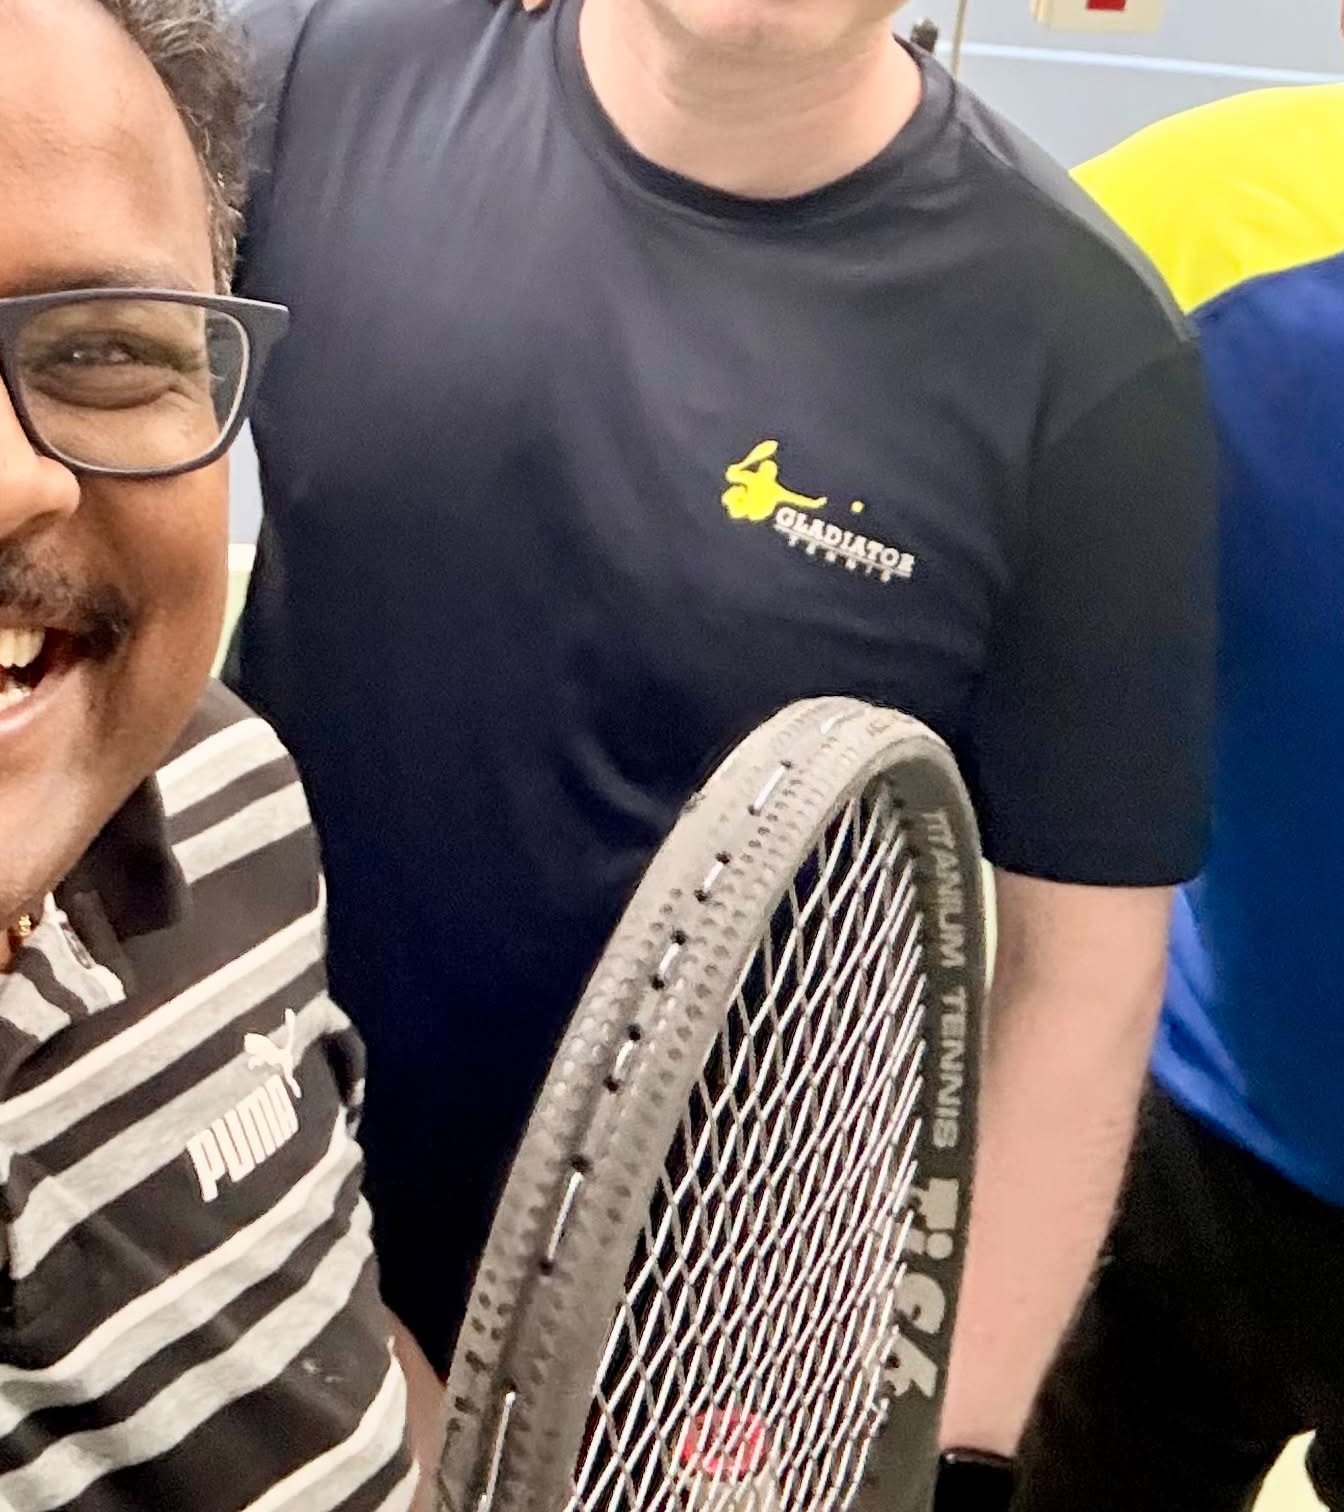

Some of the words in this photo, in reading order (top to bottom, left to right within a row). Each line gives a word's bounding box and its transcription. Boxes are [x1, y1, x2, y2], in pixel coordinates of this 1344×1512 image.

[775, 506, 915, 574] GLADIATOR
[922, 808, 967, 968] TITANIUM
[187, 1074, 300, 1203] PUMA
[933, 986, 966, 1148] TENNIS
